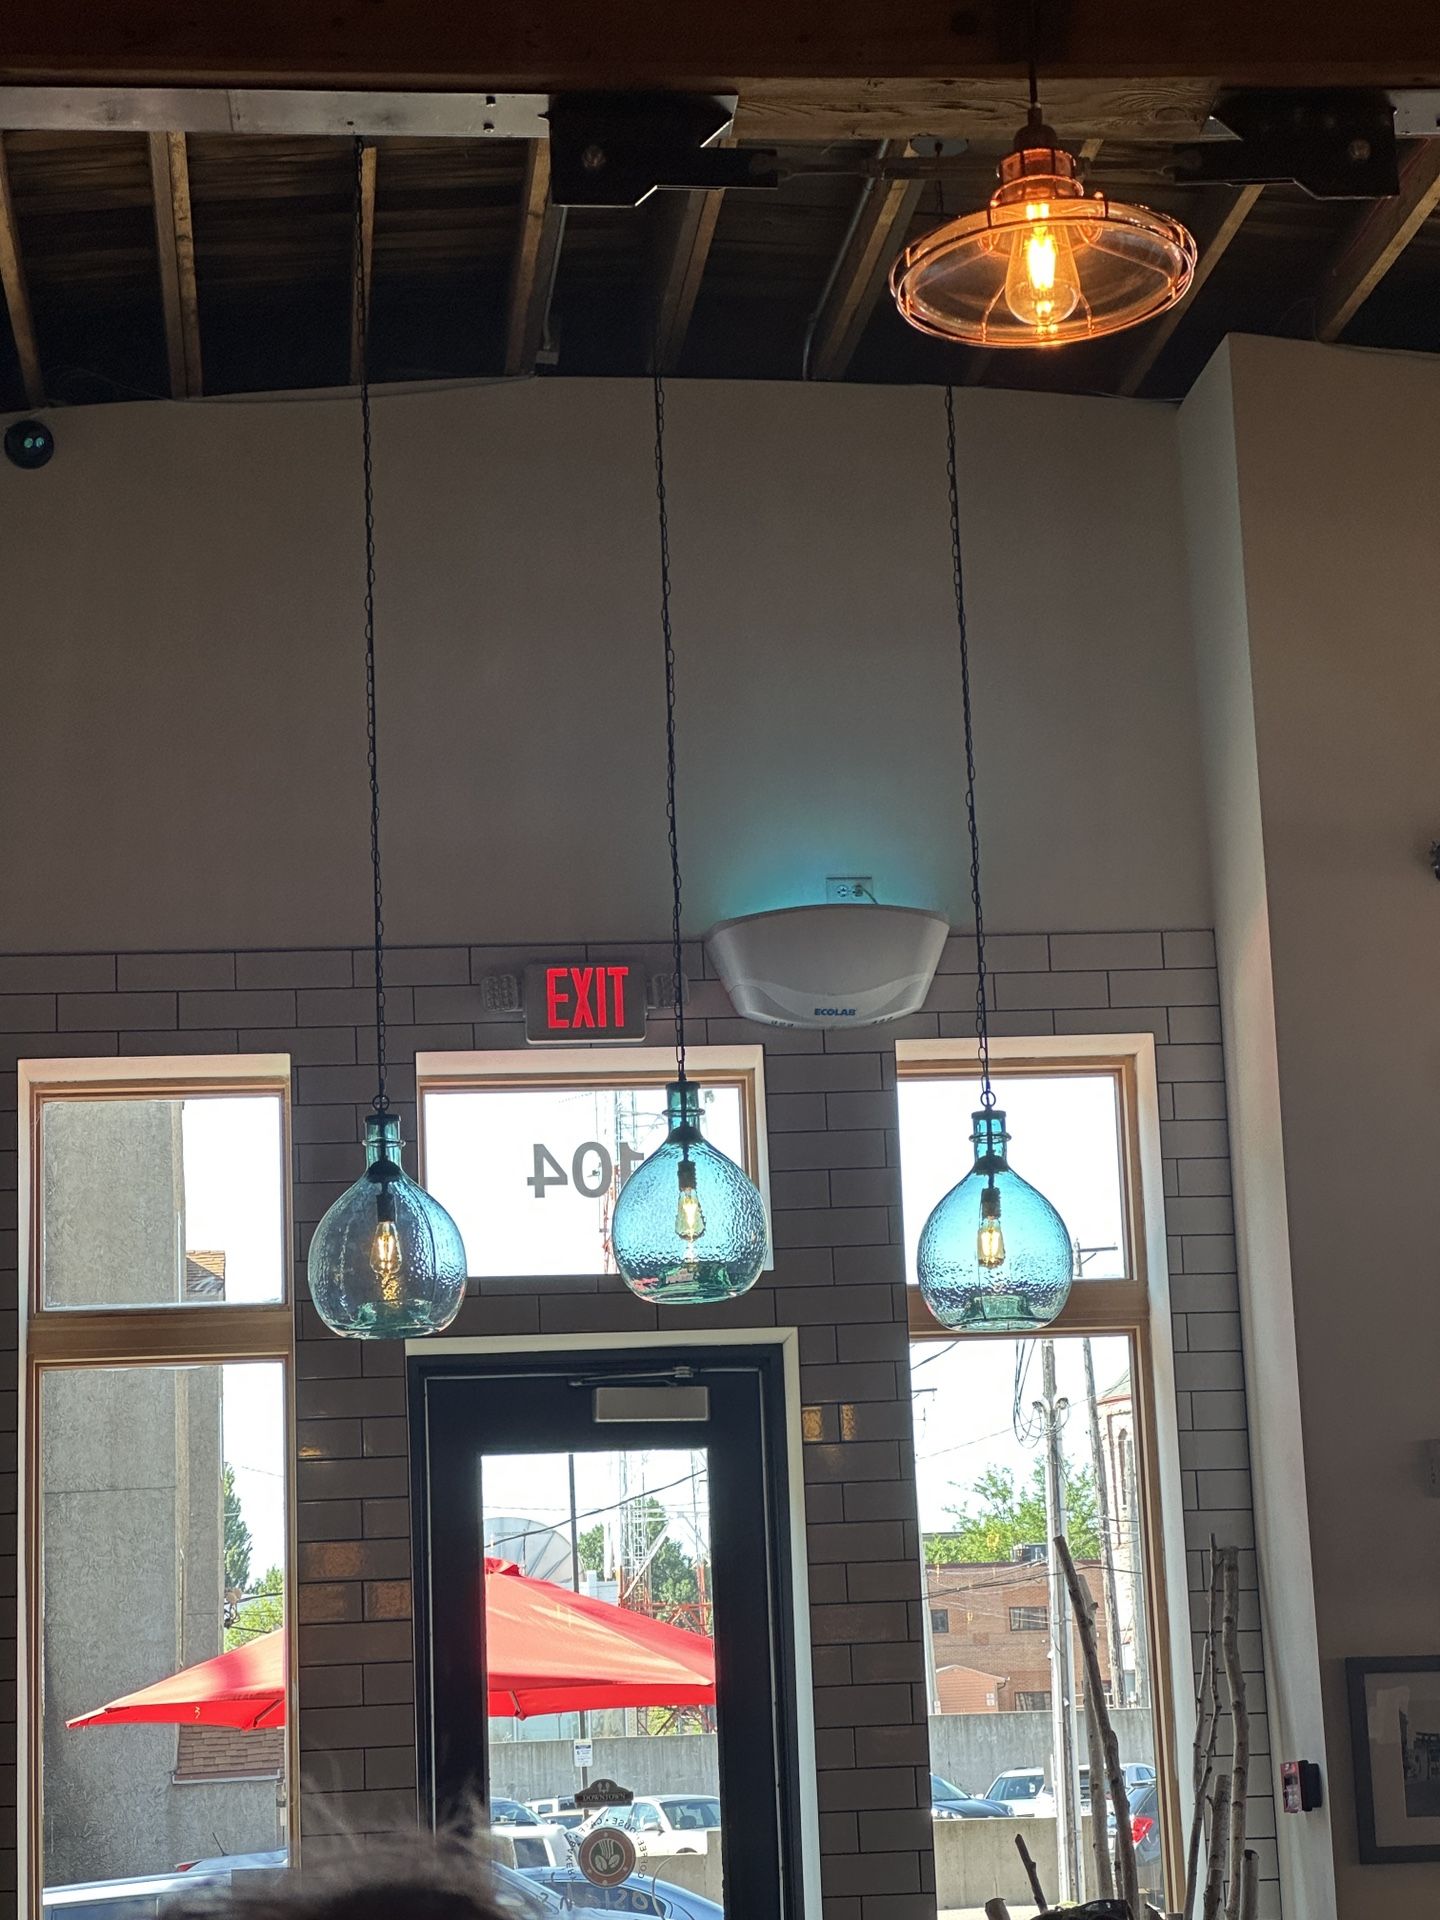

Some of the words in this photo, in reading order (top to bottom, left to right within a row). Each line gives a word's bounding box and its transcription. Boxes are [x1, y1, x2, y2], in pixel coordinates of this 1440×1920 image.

[546, 966, 629, 1029] EXIT
[814, 1007, 856, 1017] ECOLAB
[583, 1792, 626, 1801] DOWNTOWN
